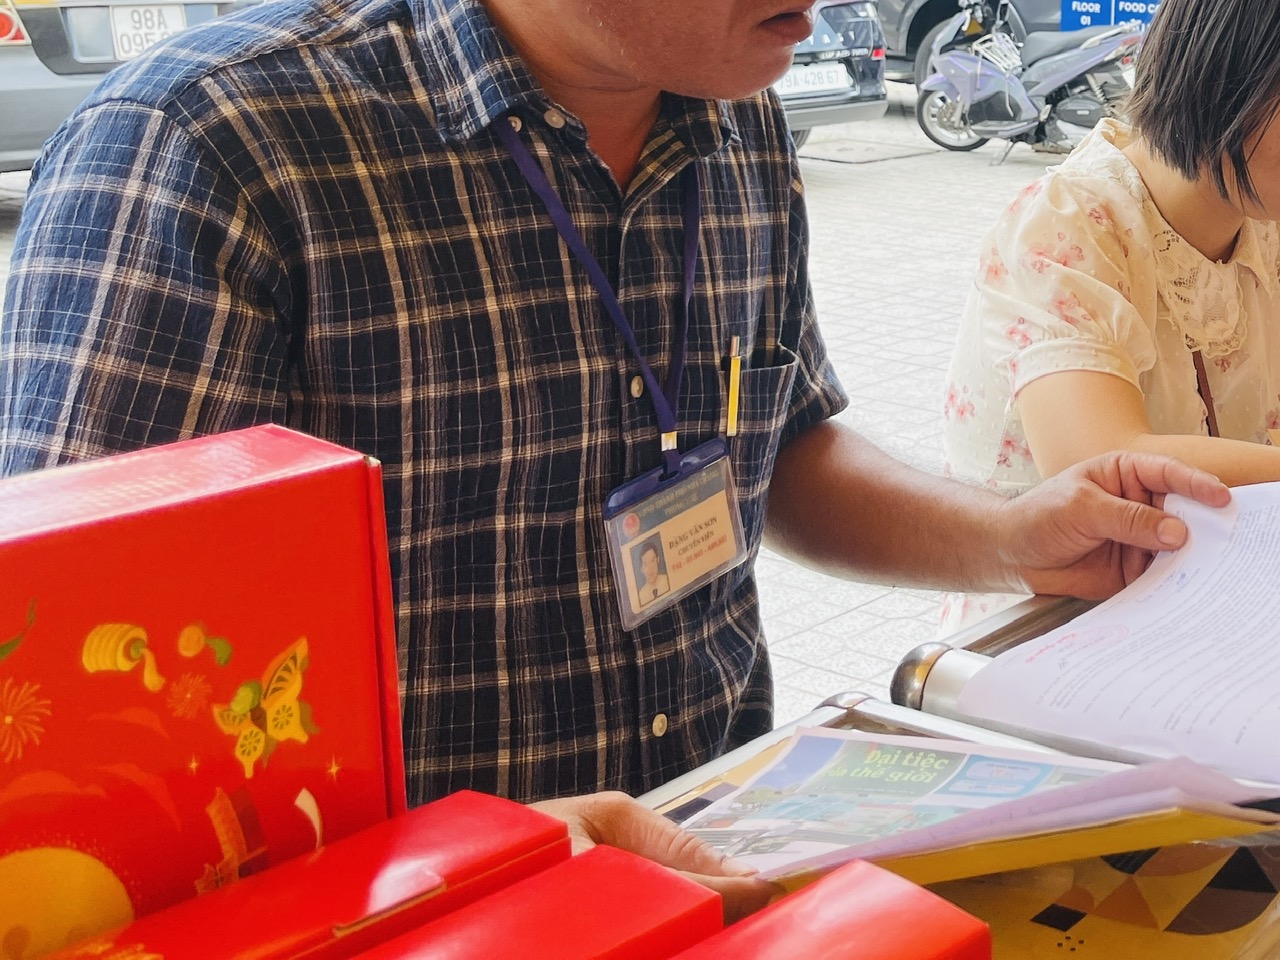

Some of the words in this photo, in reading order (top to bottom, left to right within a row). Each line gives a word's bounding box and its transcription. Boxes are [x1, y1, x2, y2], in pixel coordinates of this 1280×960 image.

[1072, 2, 1101, 14] FLOOR
[1119, 1, 1146, 14] FOOD
[131, 8, 167, 30] 98A
[1081, 16, 1092, 26] 01
[904, 752, 949, 773] tiệc
[849, 765, 885, 780] thế
[885, 767, 938, 784] giới
